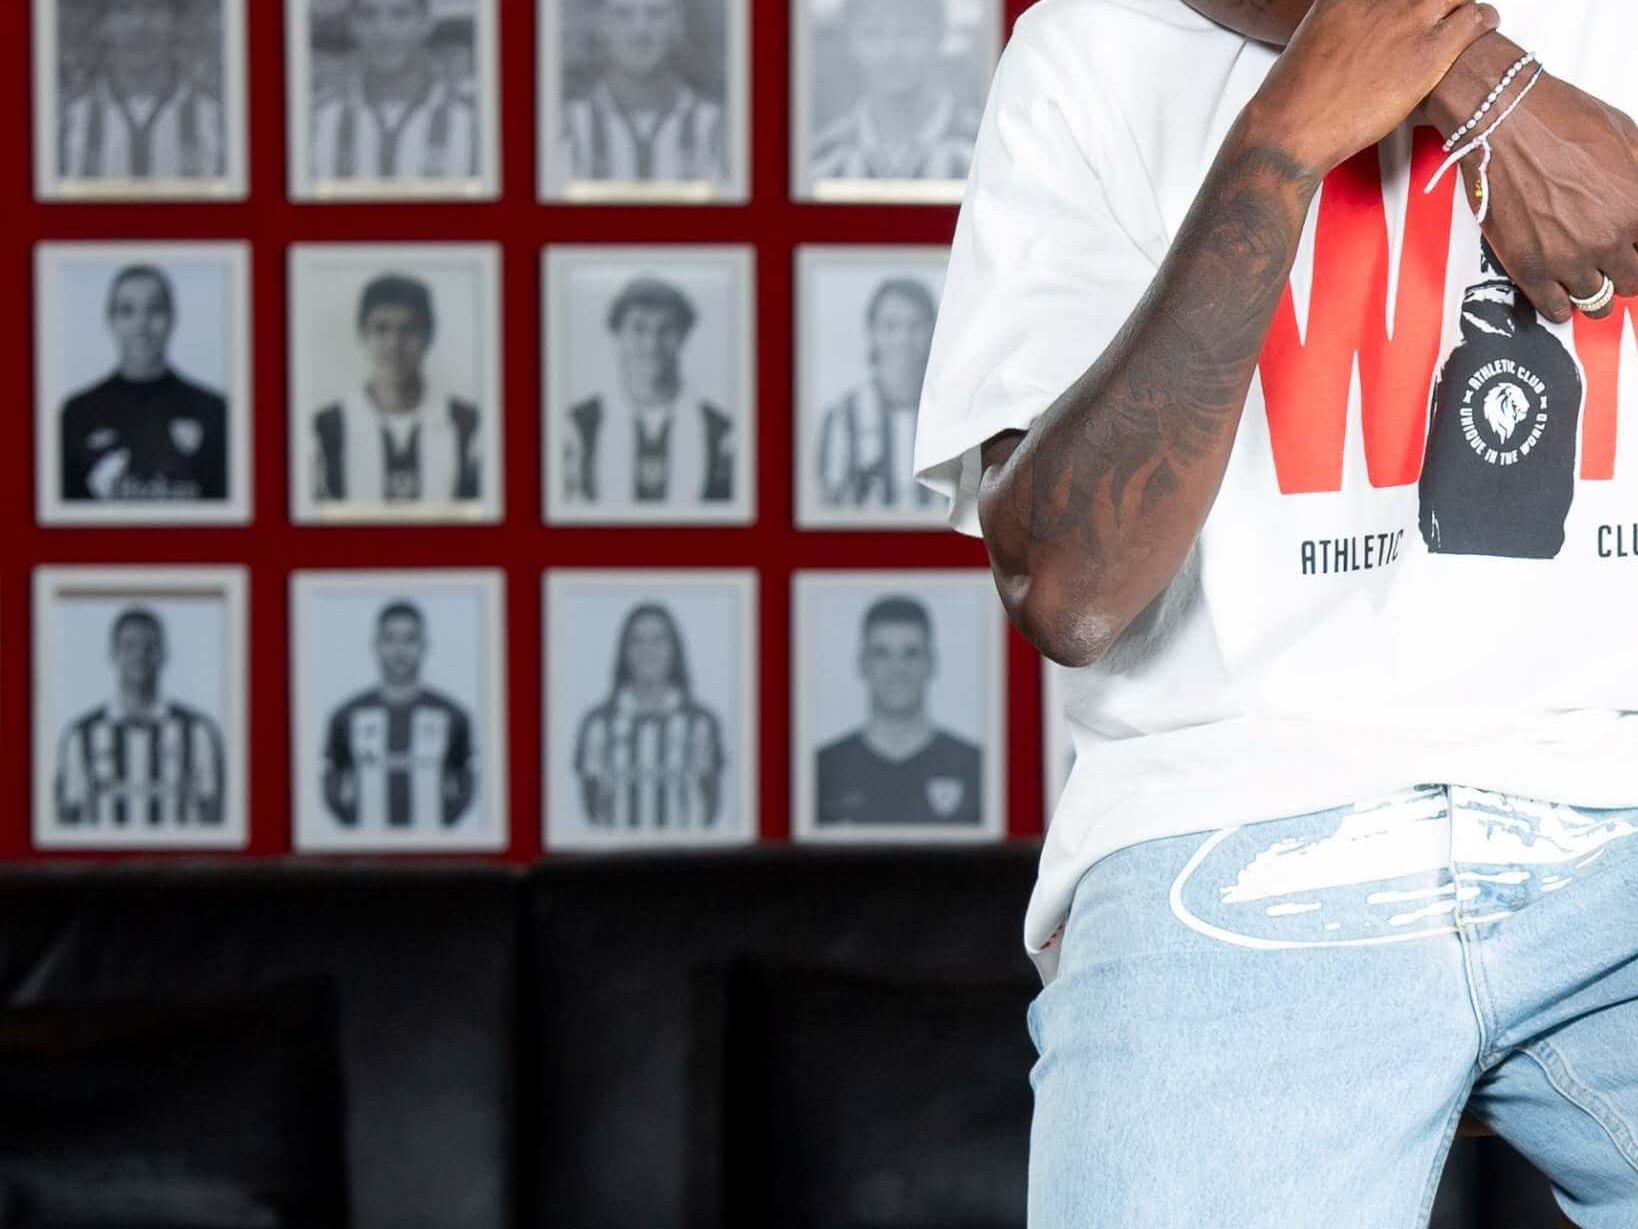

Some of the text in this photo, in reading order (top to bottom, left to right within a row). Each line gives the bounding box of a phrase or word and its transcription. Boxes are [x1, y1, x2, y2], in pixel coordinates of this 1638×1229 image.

[1468, 359, 1545, 394] ATHLETIC CLUB
[1460, 407, 1547, 466] UNIQUE IN THE WORLD
